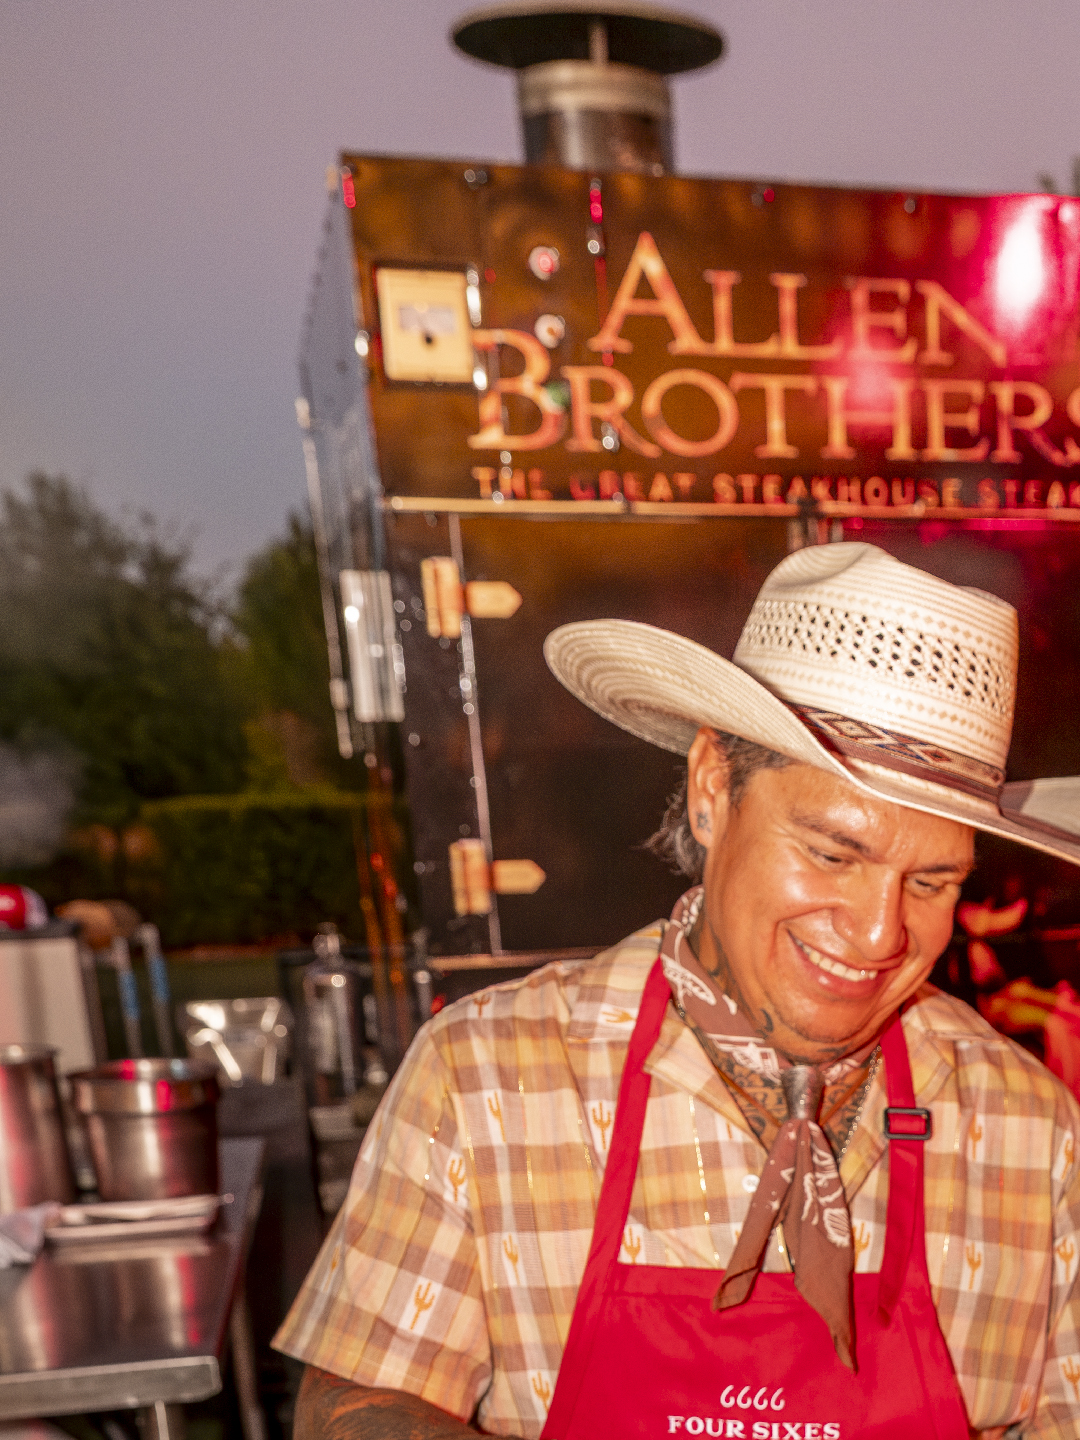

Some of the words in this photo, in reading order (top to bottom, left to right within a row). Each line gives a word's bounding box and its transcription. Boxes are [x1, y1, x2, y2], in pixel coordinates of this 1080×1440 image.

[587, 231, 1008, 367] ALLEN
[470, 466, 553, 501] THE
[569, 470, 698, 502] GREAT
[712, 473, 964, 508] STEAKHOUSE
[719, 1384, 786, 1411] 6666
[667, 1415, 747, 1439] FOUR
